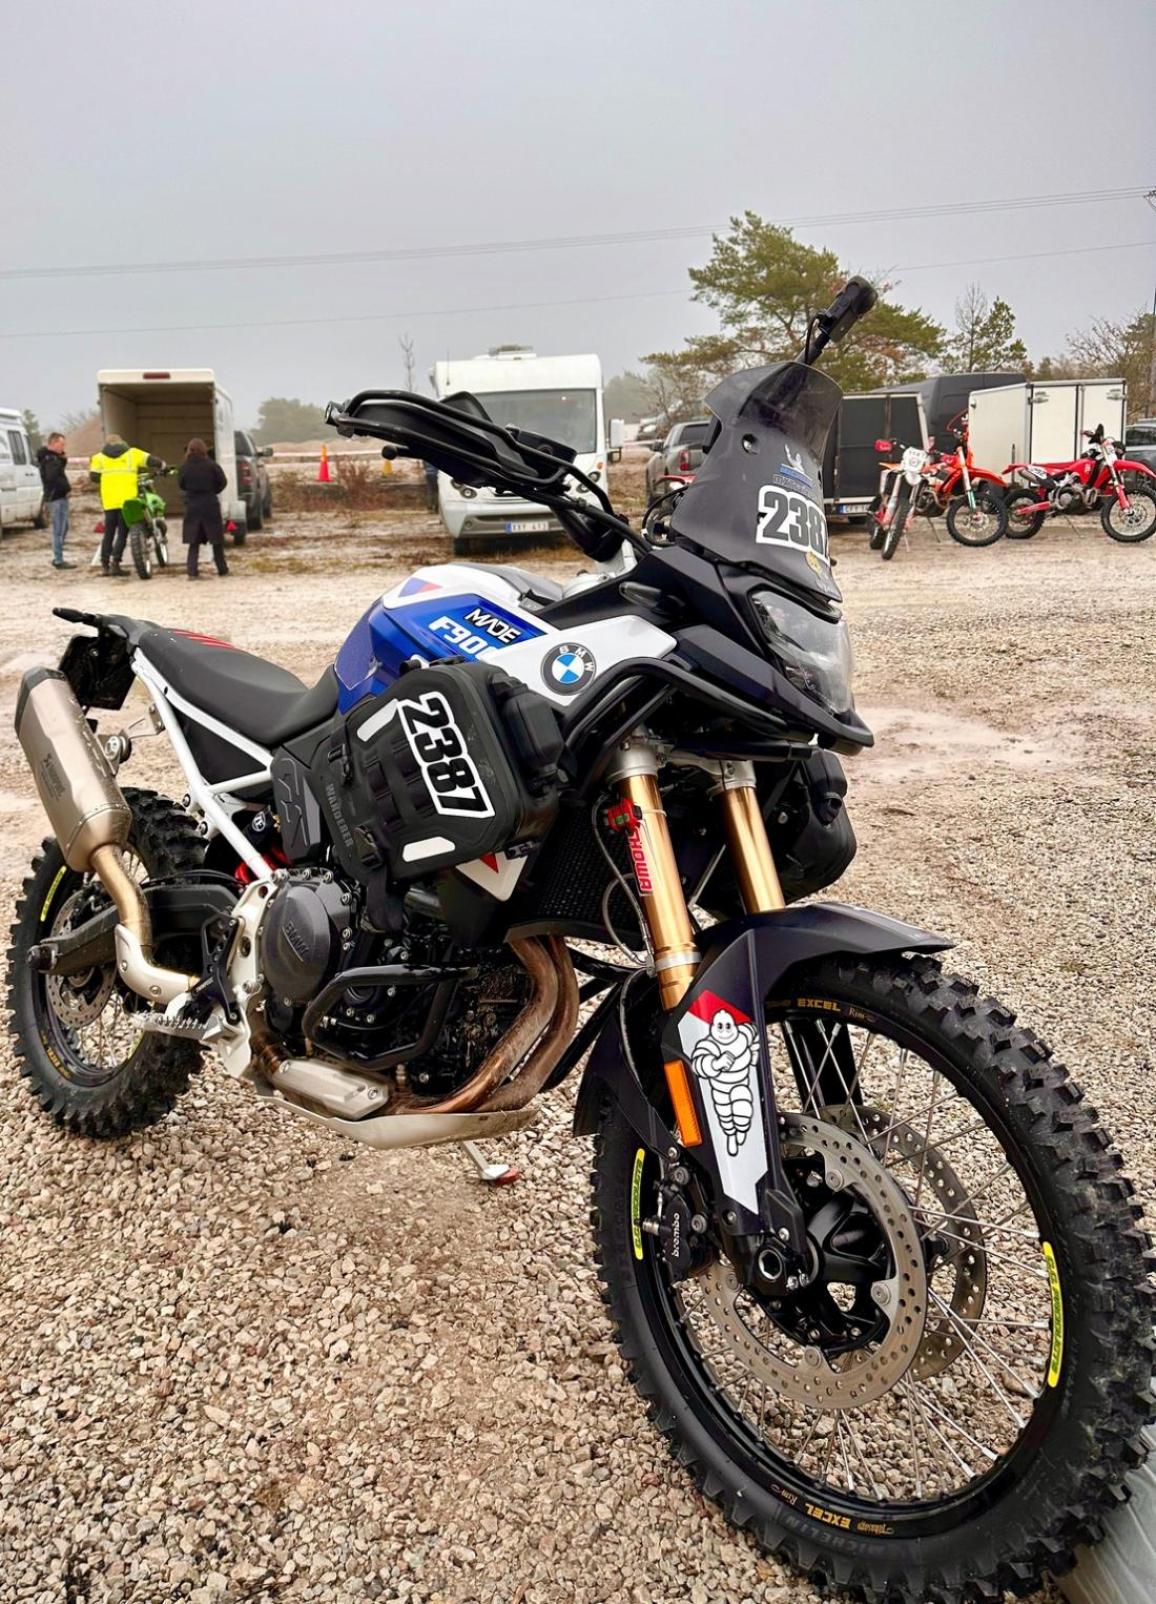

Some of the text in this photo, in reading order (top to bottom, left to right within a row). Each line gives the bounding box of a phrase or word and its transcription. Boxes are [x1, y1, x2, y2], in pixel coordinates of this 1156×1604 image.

[759, 488, 829, 561] 238
[465, 608, 521, 643] MADE
[559, 644, 595, 672] BMW
[399, 694, 491, 815] 2387
[797, 998, 841, 1012] EXCEL
[671, 1212, 680, 1258] brembo
[804, 1502, 851, 1529] EXCEL
